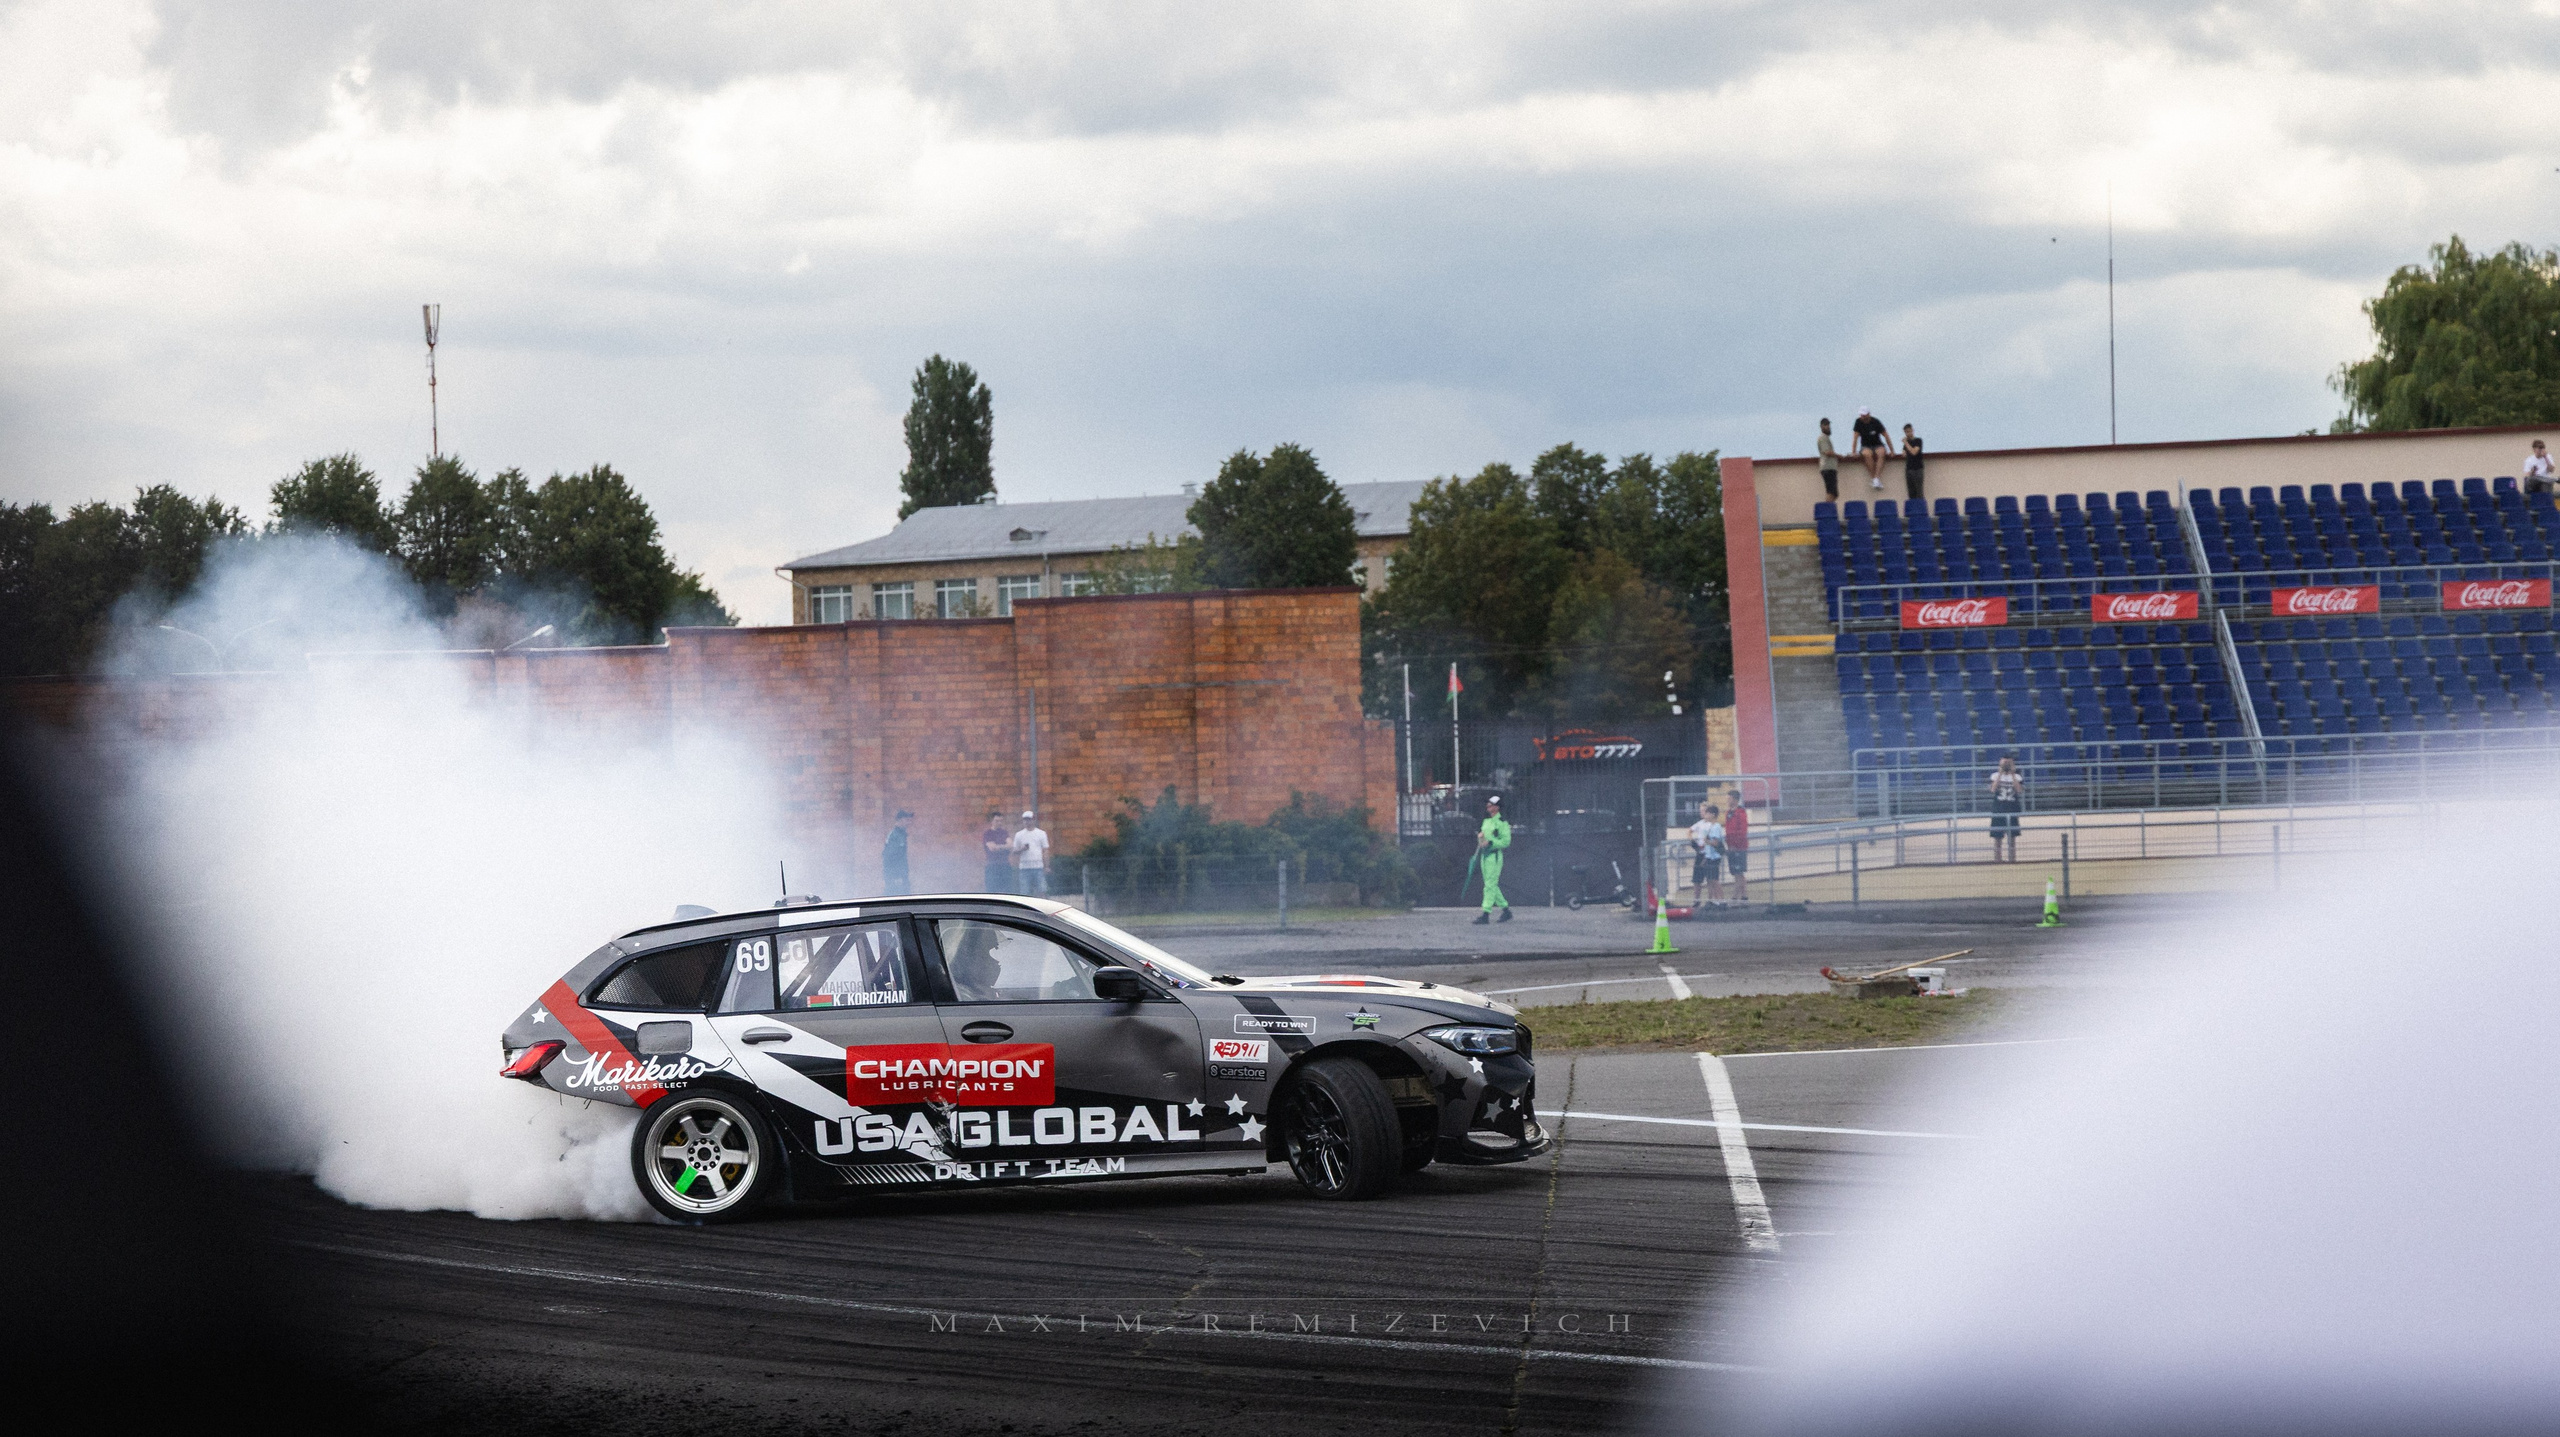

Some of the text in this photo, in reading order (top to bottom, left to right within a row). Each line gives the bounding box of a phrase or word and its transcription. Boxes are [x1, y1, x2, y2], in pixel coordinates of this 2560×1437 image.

[736, 941, 770, 973] 69
[833, 990, 907, 1006] K. KOROZHAN
[1242, 1020, 1275, 1028] READY
[562, 1049, 732, 1088] Marikaro
[1220, 1067, 1265, 1077] carstore
[652, 1081, 688, 1089] SELECT
[880, 1080, 1015, 1091] LUBRICANTS
[814, 1104, 1200, 1156] USA GLOBAL
[934, 1157, 1125, 1180] DRIFT TEAM
